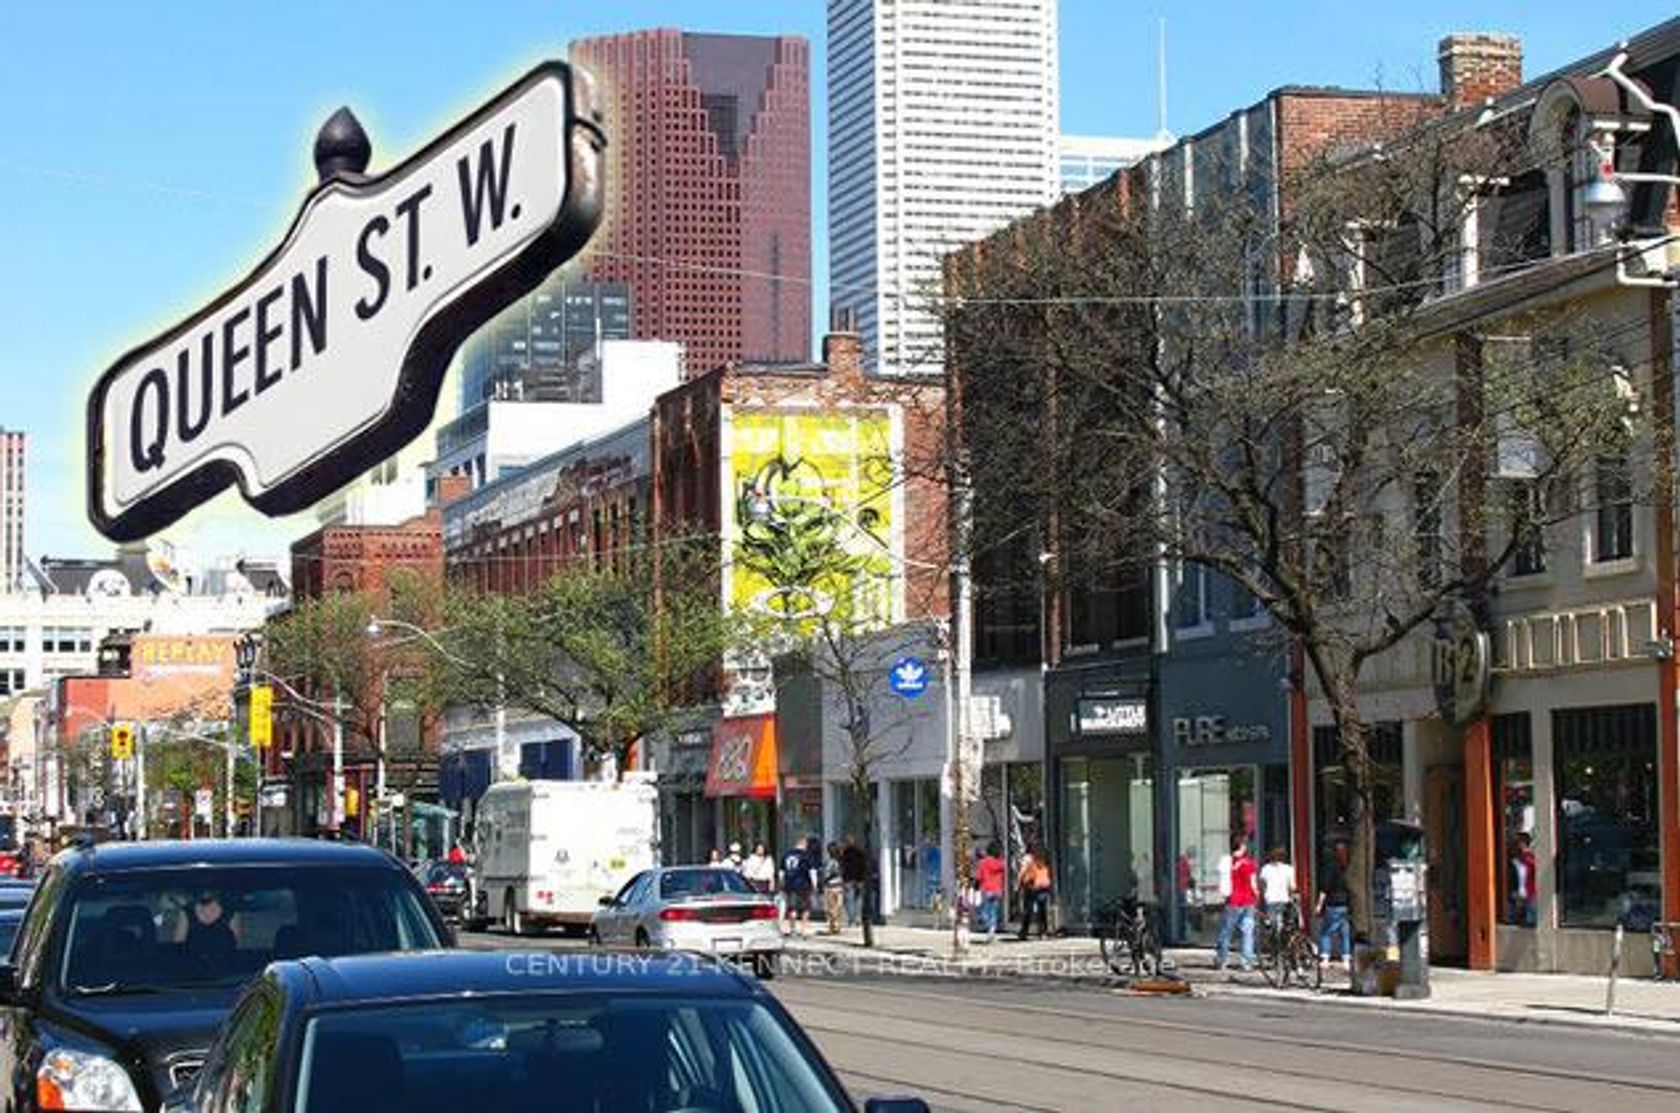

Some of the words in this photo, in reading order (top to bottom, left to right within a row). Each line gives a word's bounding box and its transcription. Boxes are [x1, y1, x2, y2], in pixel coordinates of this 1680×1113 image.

[130, 255, 329, 472] QUEEN
[355, 184, 432, 321] ST.
[457, 123, 521, 247] W.
[1174, 715, 1225, 745] PURE
